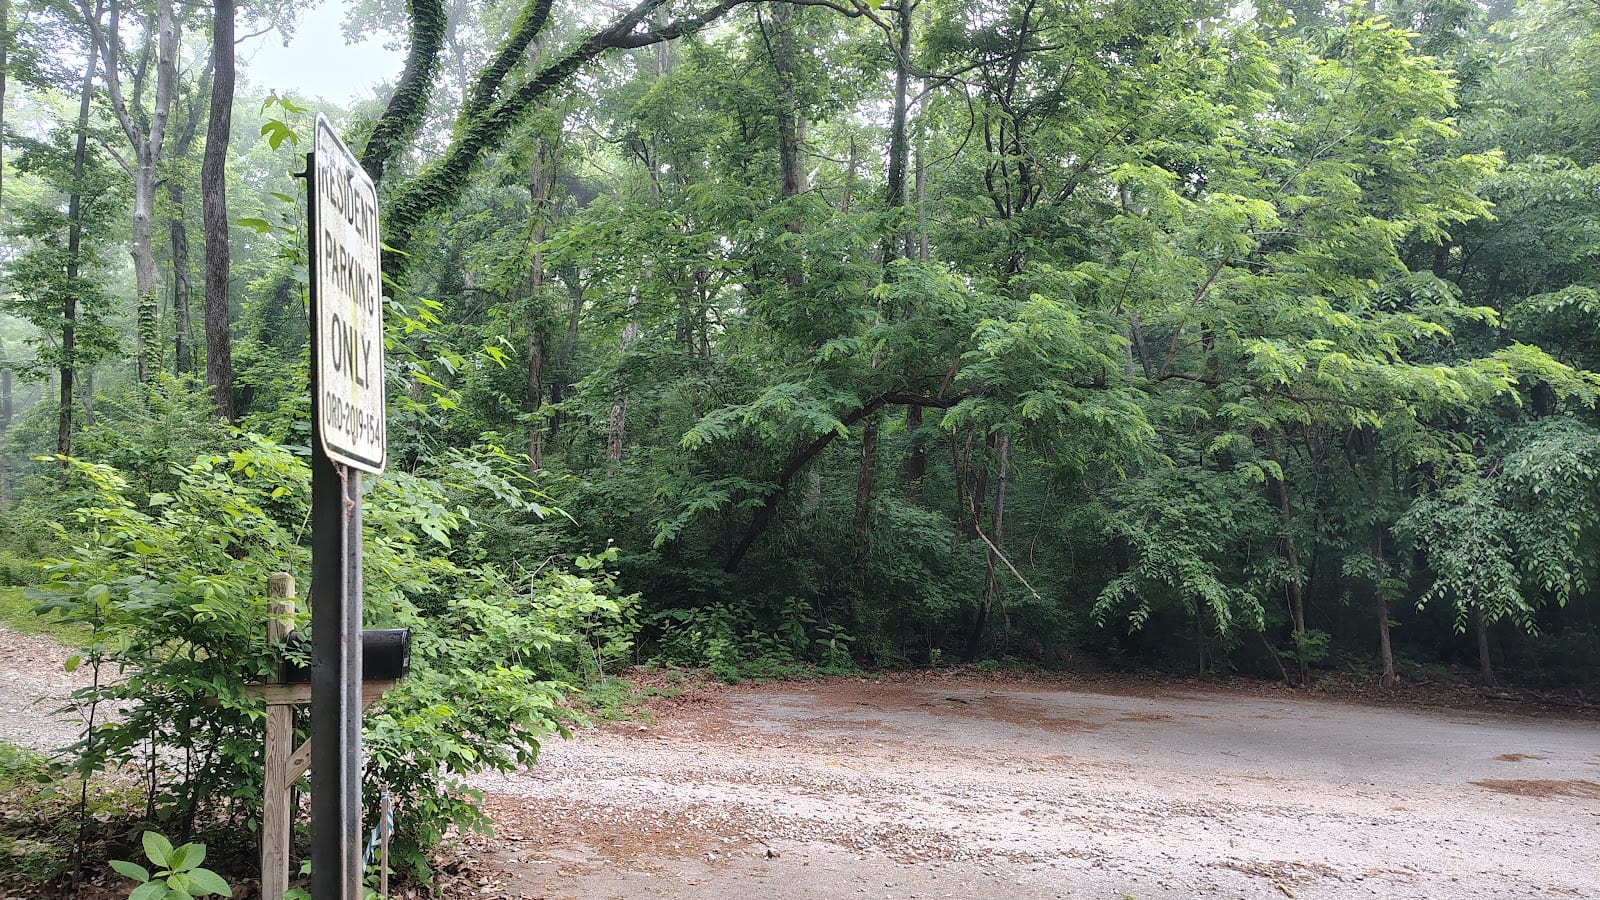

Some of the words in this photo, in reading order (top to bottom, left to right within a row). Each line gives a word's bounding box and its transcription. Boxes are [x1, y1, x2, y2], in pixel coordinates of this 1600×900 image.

[320, 145, 374, 249] RESIDENT
[325, 227, 374, 317] PARKING
[331, 312, 371, 390] ONLY
[325, 390, 380, 449] ORD-2019-154
